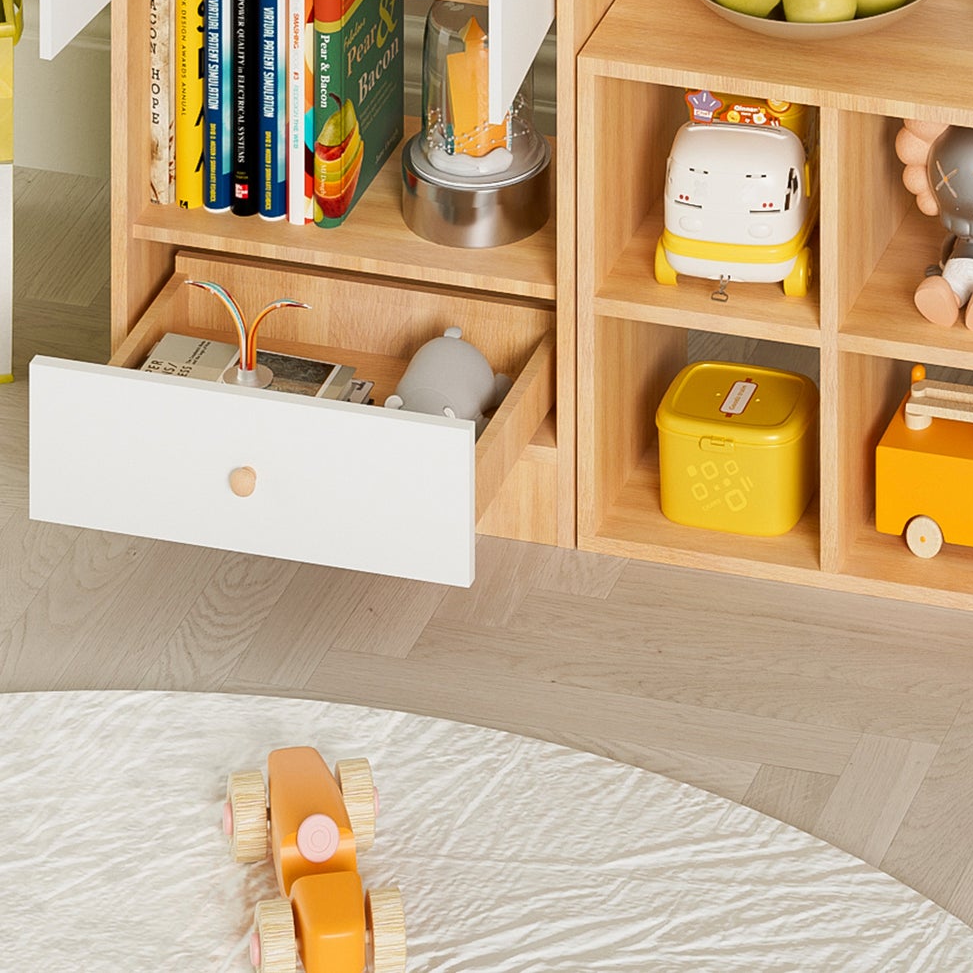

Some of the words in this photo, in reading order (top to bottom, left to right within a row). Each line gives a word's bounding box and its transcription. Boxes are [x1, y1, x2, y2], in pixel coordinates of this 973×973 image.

[208, 0, 219, 30] VIRTUAL
[263, 7, 274, 38] VIRTUAL
[208, 31, 219, 63] PATIENT
[236, 28, 245, 66] QUALITY
[263, 39, 274, 72] PATIENT
[320, 34, 330, 59] Pear
[347, 24, 377, 78] Pear
[320, 62, 330, 73] &
[358, 37, 399, 106] Bacon
[151, 67, 160, 125] HOPE
[208, 63, 219, 111] SIMULATION
[237, 74, 245, 124] ELECTRICAL
[263, 71, 274, 118] SIMULATION
[320, 74, 330, 109] Bacon
[237, 126, 245, 164] SYSTEMS
